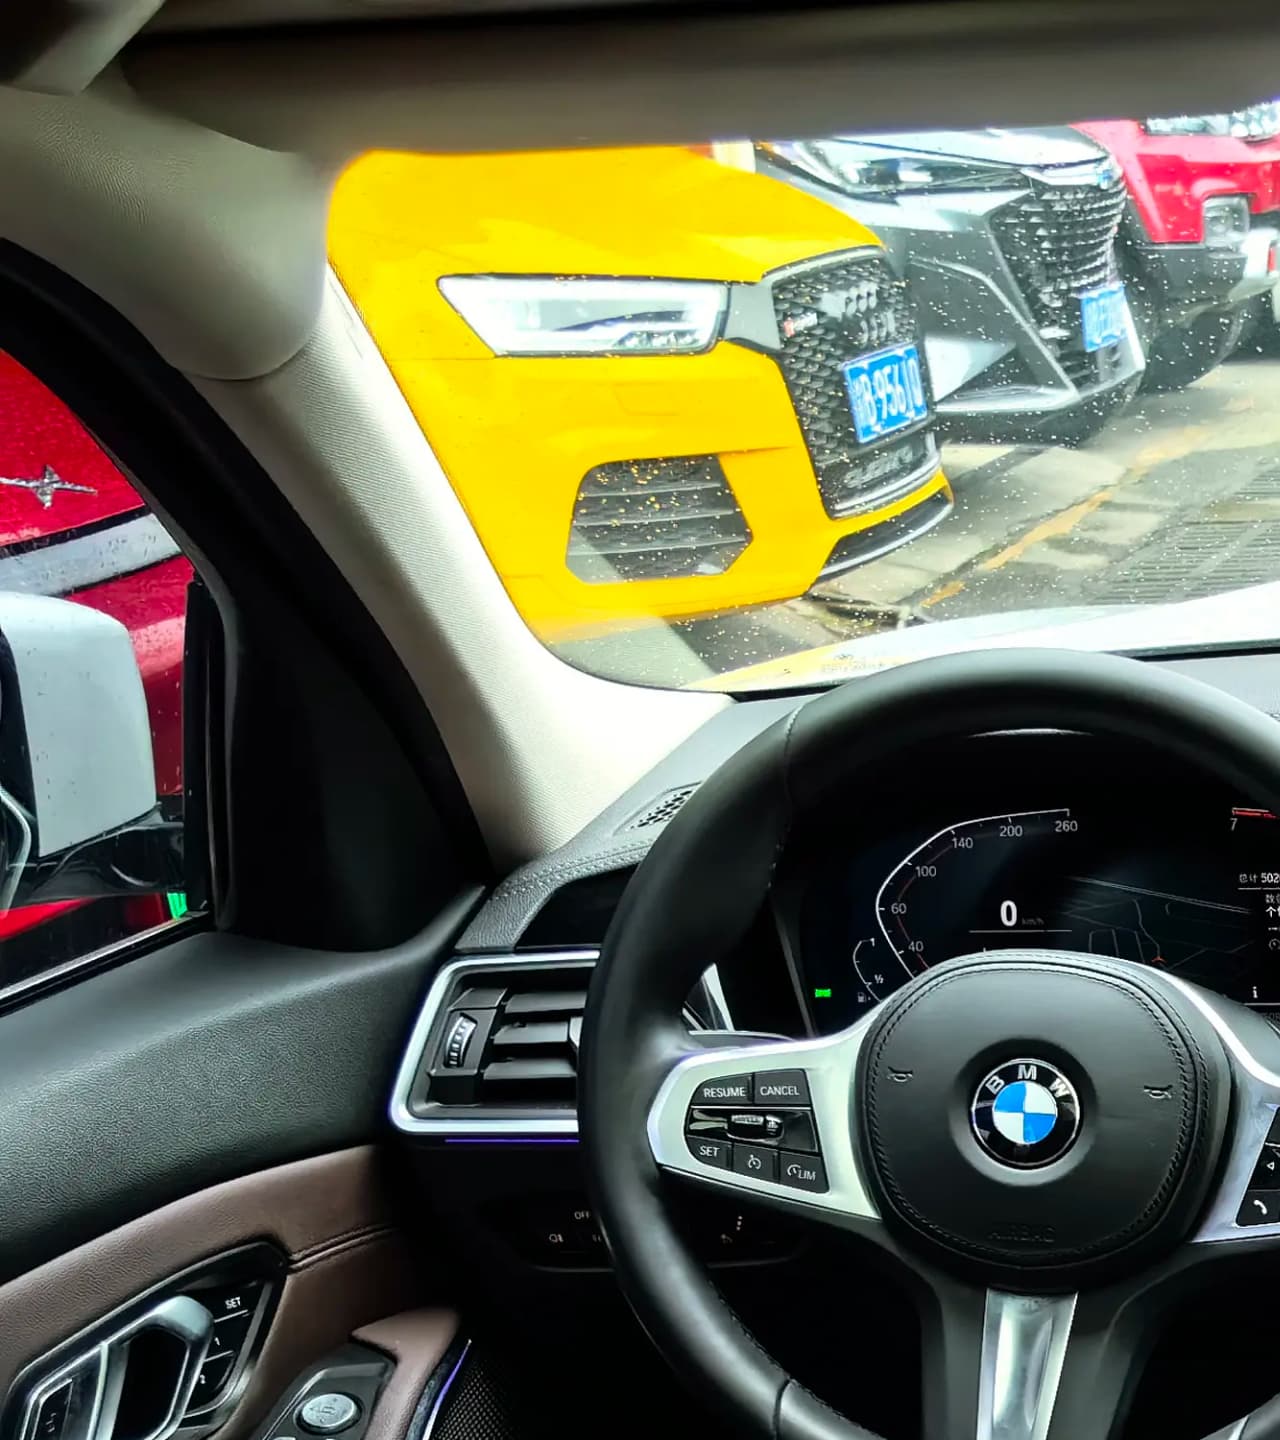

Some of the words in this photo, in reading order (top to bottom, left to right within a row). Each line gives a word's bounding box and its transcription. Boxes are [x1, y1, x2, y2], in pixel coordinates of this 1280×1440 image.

[1054, 820, 1078, 832] 260
[1230, 818, 1238, 831] 7
[999, 825, 1023, 837] 200
[952, 837, 974, 849] 140
[915, 866, 937, 877] 100
[891, 903, 907, 914] 60
[1000, 900, 1017, 926] 0
[908, 940, 924, 952] 40
[985, 1063, 1070, 1098] BMW
[703, 1086, 747, 1098] RESUME
[760, 1085, 800, 1097] CANCEL
[699, 1145, 720, 1158] SET
[798, 1170, 817, 1181] LIM
[225, 1296, 241, 1309] SET
